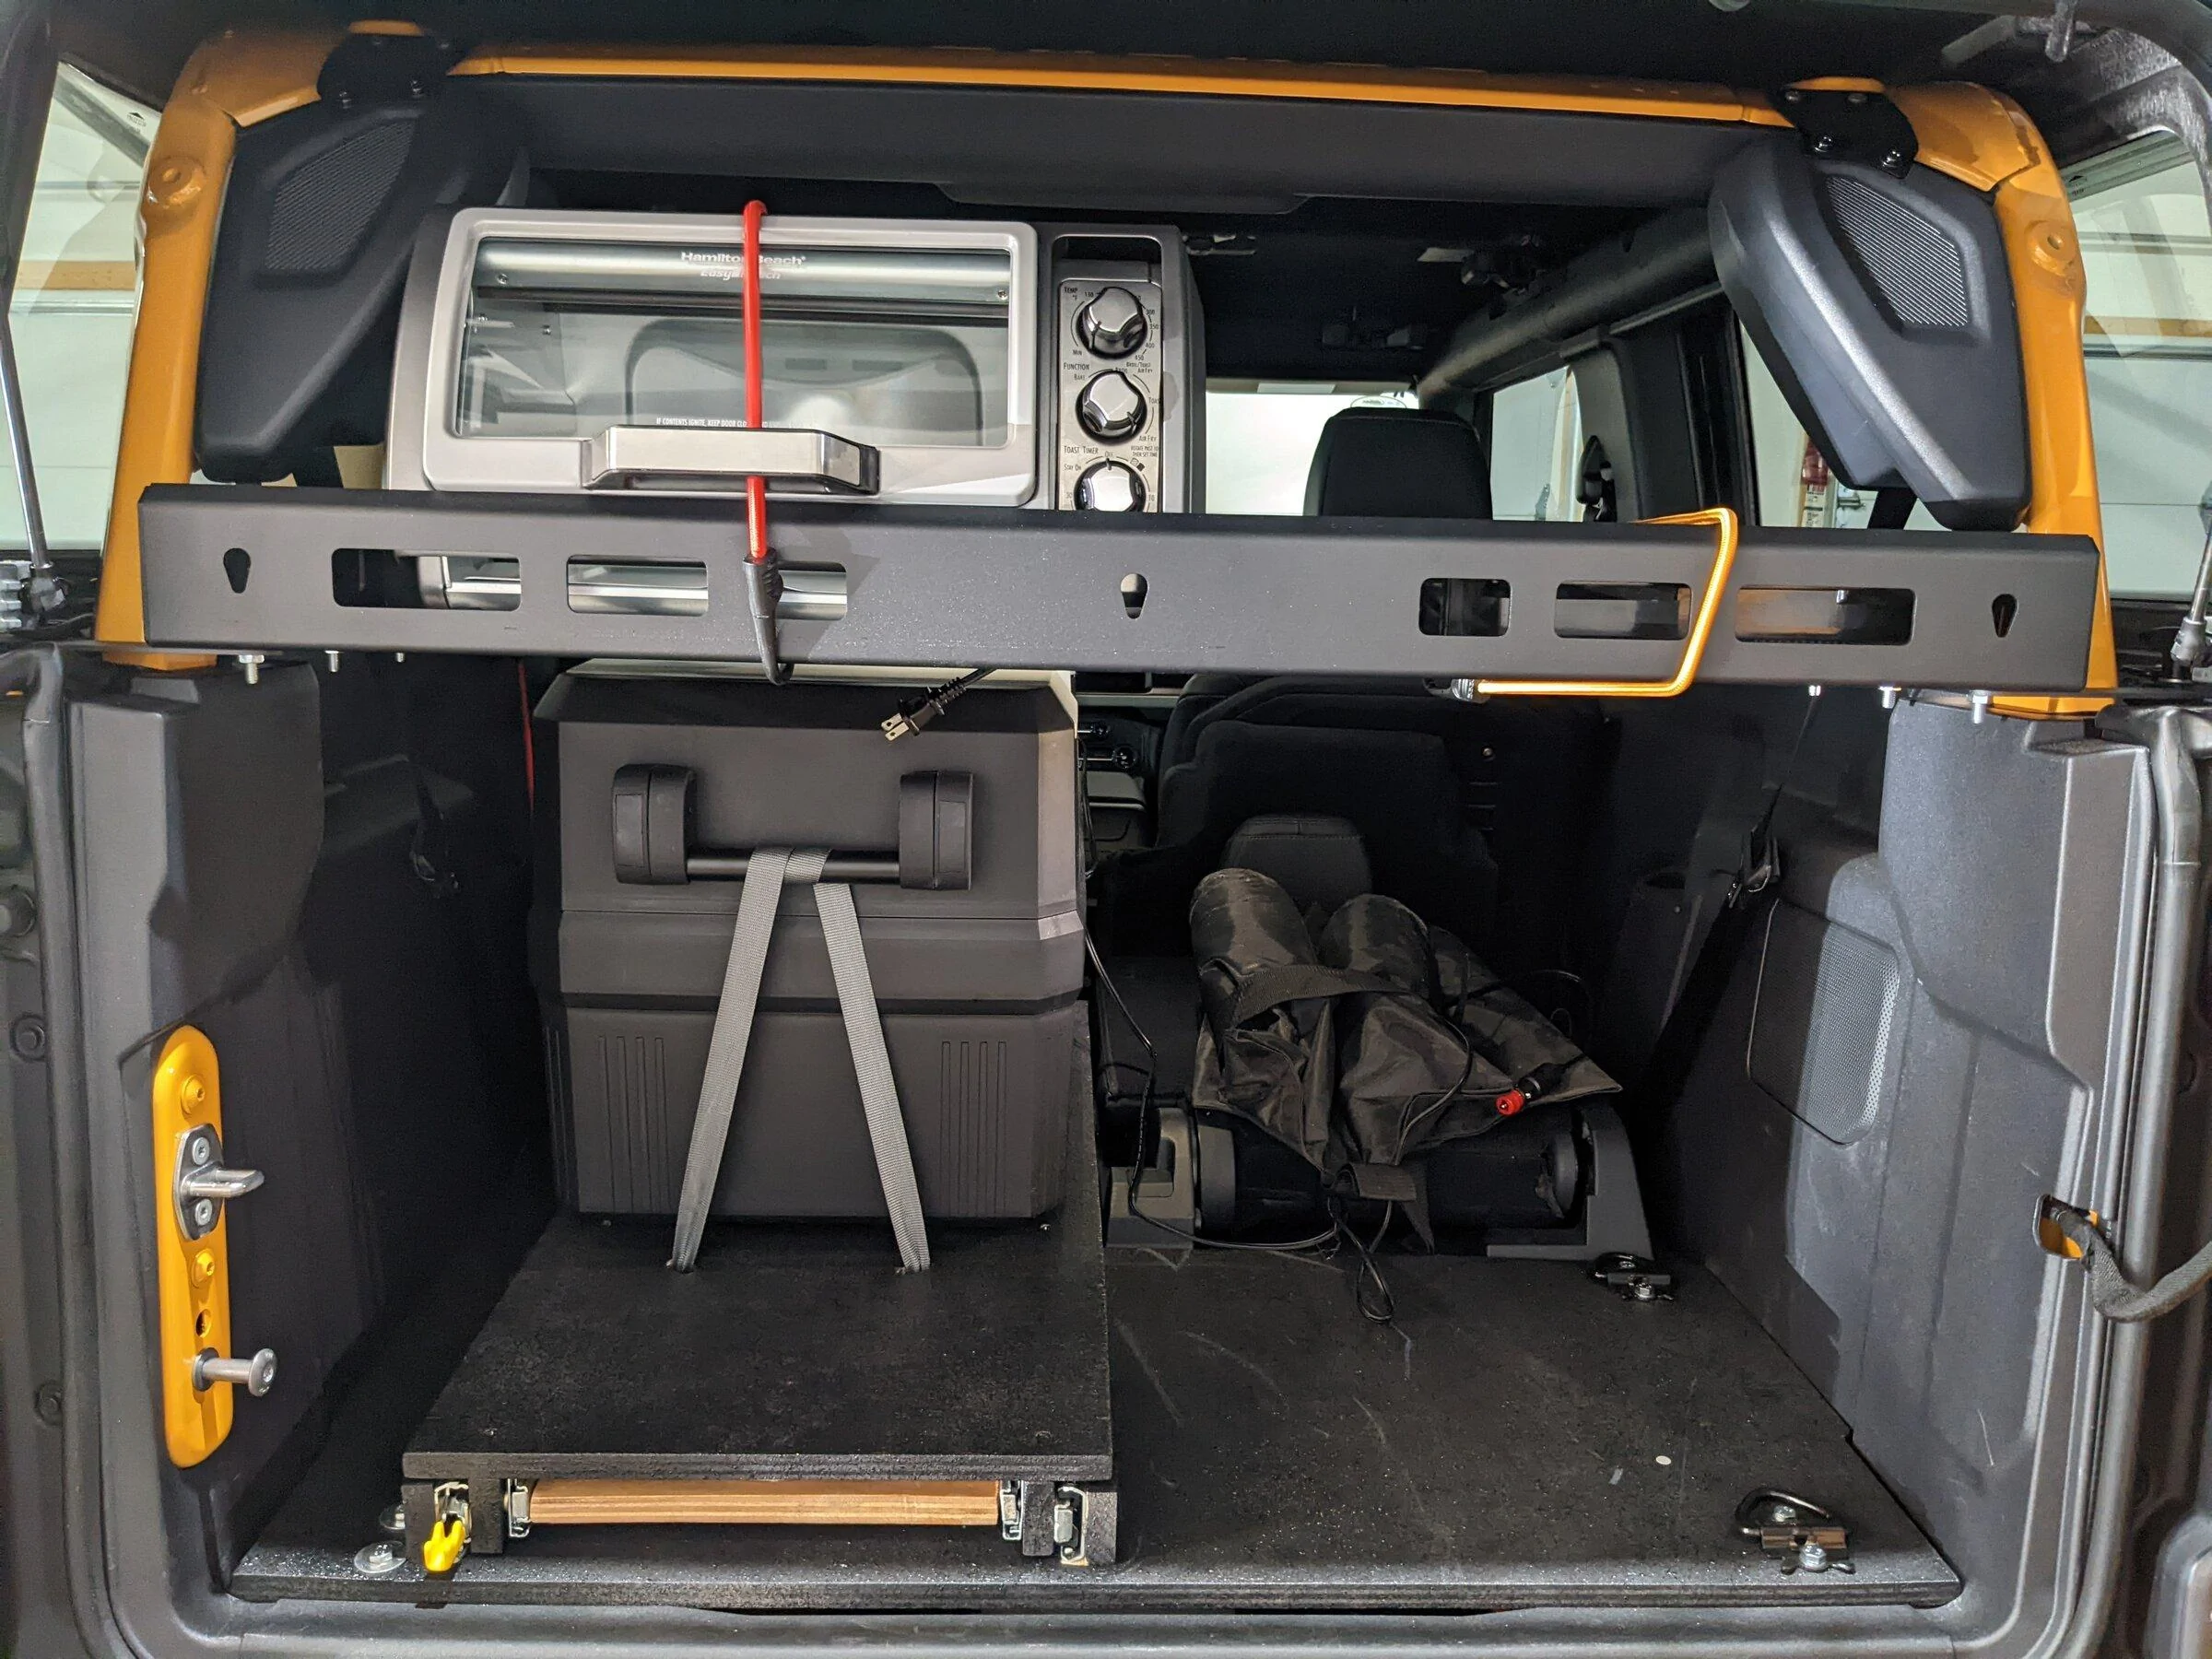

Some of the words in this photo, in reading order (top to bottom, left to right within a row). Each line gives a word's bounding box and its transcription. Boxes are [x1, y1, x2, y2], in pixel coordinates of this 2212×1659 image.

[1063, 362, 1090, 371] FUNCTION
[1064, 445, 1081, 454] TOAST
[1082, 446, 1099, 454] TIMER
